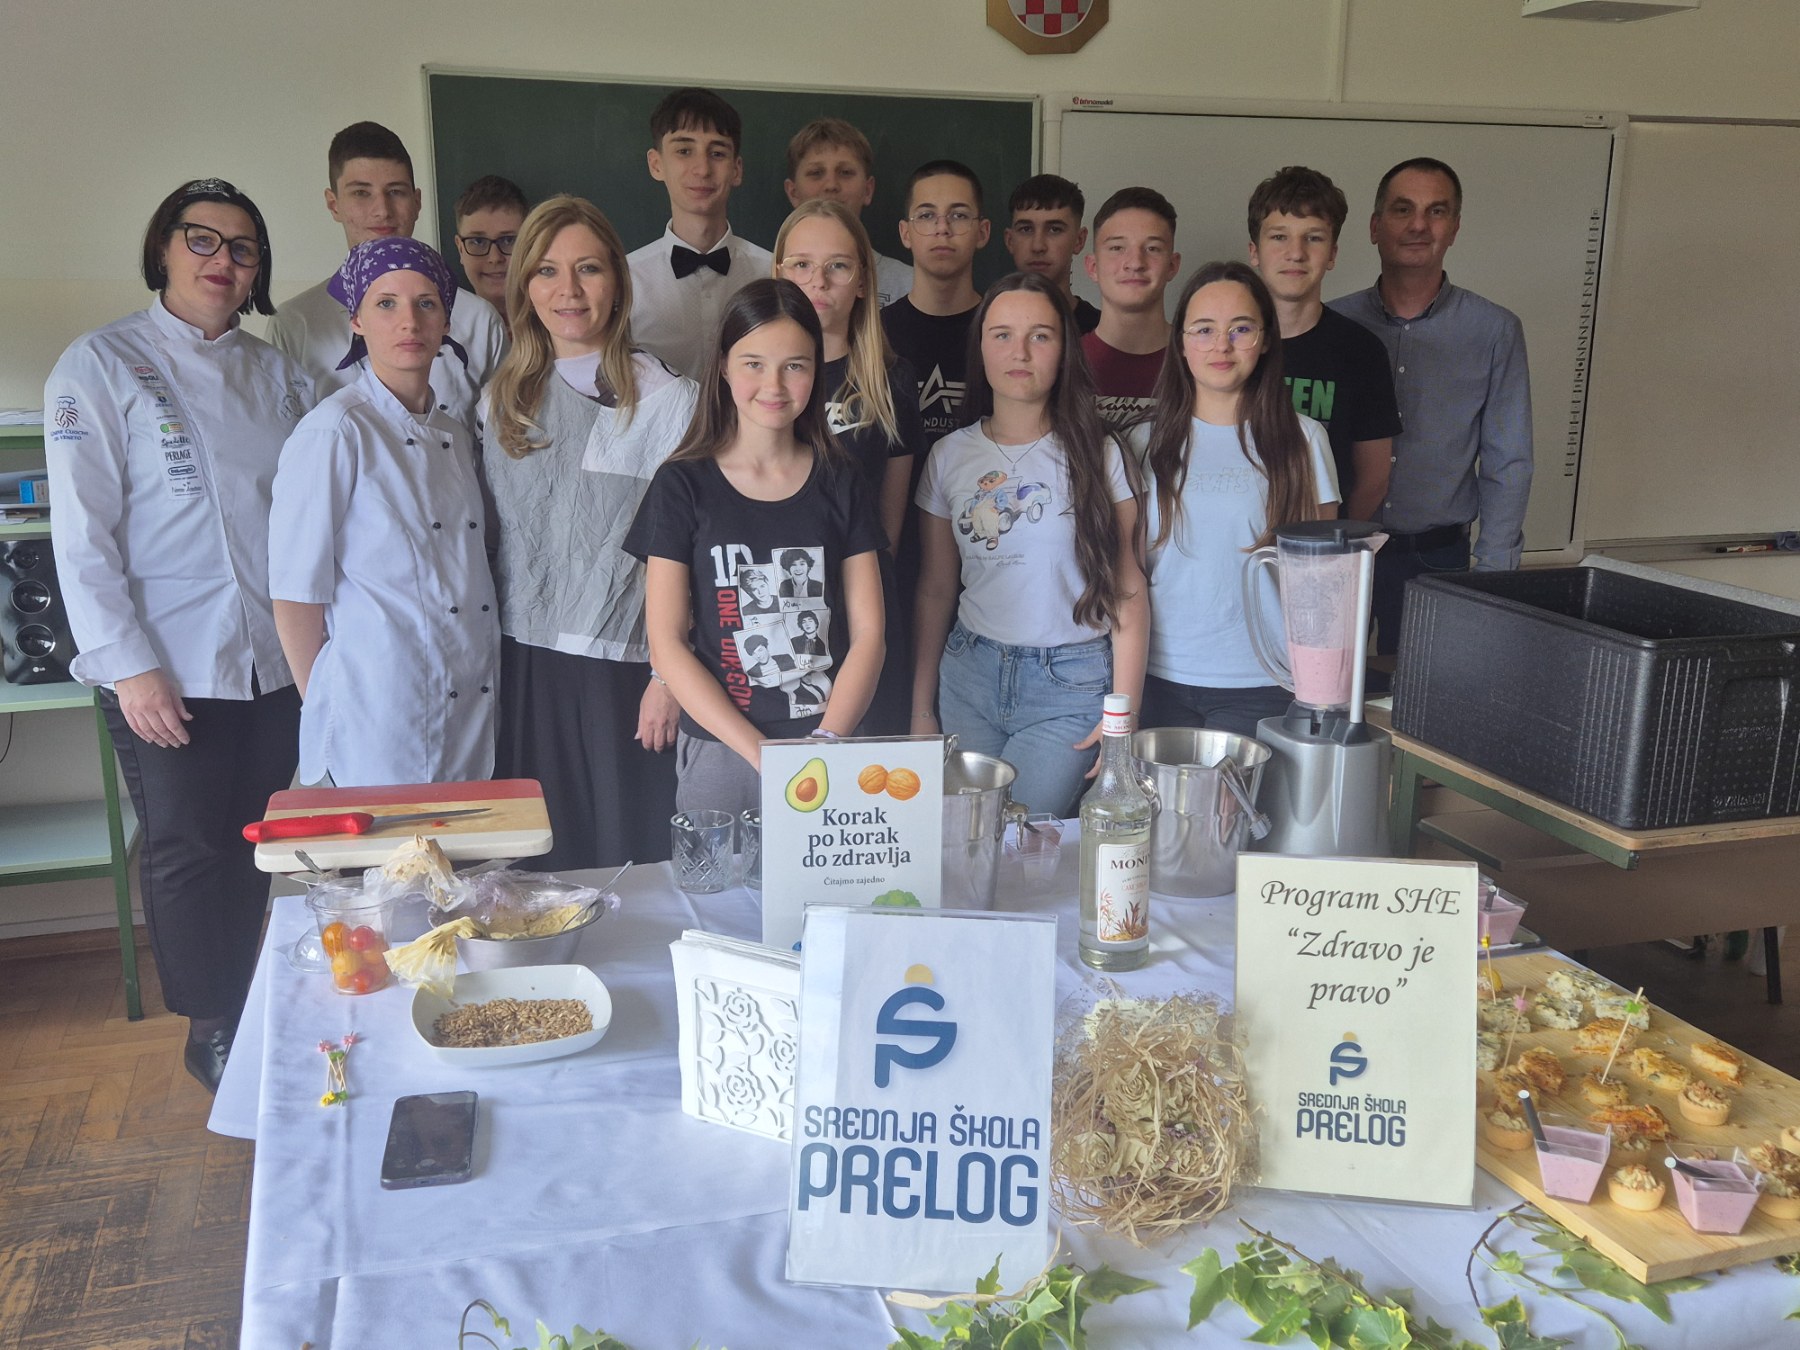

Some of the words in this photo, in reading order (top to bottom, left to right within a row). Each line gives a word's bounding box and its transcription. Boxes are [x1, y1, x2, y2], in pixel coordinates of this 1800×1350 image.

[1284, 377, 1335, 420] EN
[717, 589, 742, 628] ONE
[822, 807, 887, 826] Korak
[808, 834, 834, 849] po
[840, 827, 899, 846] korak
[802, 850, 827, 868] do
[832, 847, 911, 868] zdravlja
[1111, 854, 1151, 870] MONI
[823, 876, 855, 887] Čitajmo
[856, 875, 886, 886] zajedno
[1260, 880, 1380, 917] Program
[1386, 887, 1461, 915] SHE
[1288, 927, 1403, 961] “Zdravo
[1404, 937, 1436, 971] je
[1307, 977, 1408, 1010] pravo”
[1298, 1092, 1359, 1111] SREDNJA
[1364, 1093, 1407, 1114] ŠKOLA
[804, 1104, 937, 1144] SREDNJA
[949, 1104, 1041, 1150] ŠKOLA
[1296, 1108, 1406, 1147] PRELOG
[798, 1142, 1039, 1227] PRELOG
